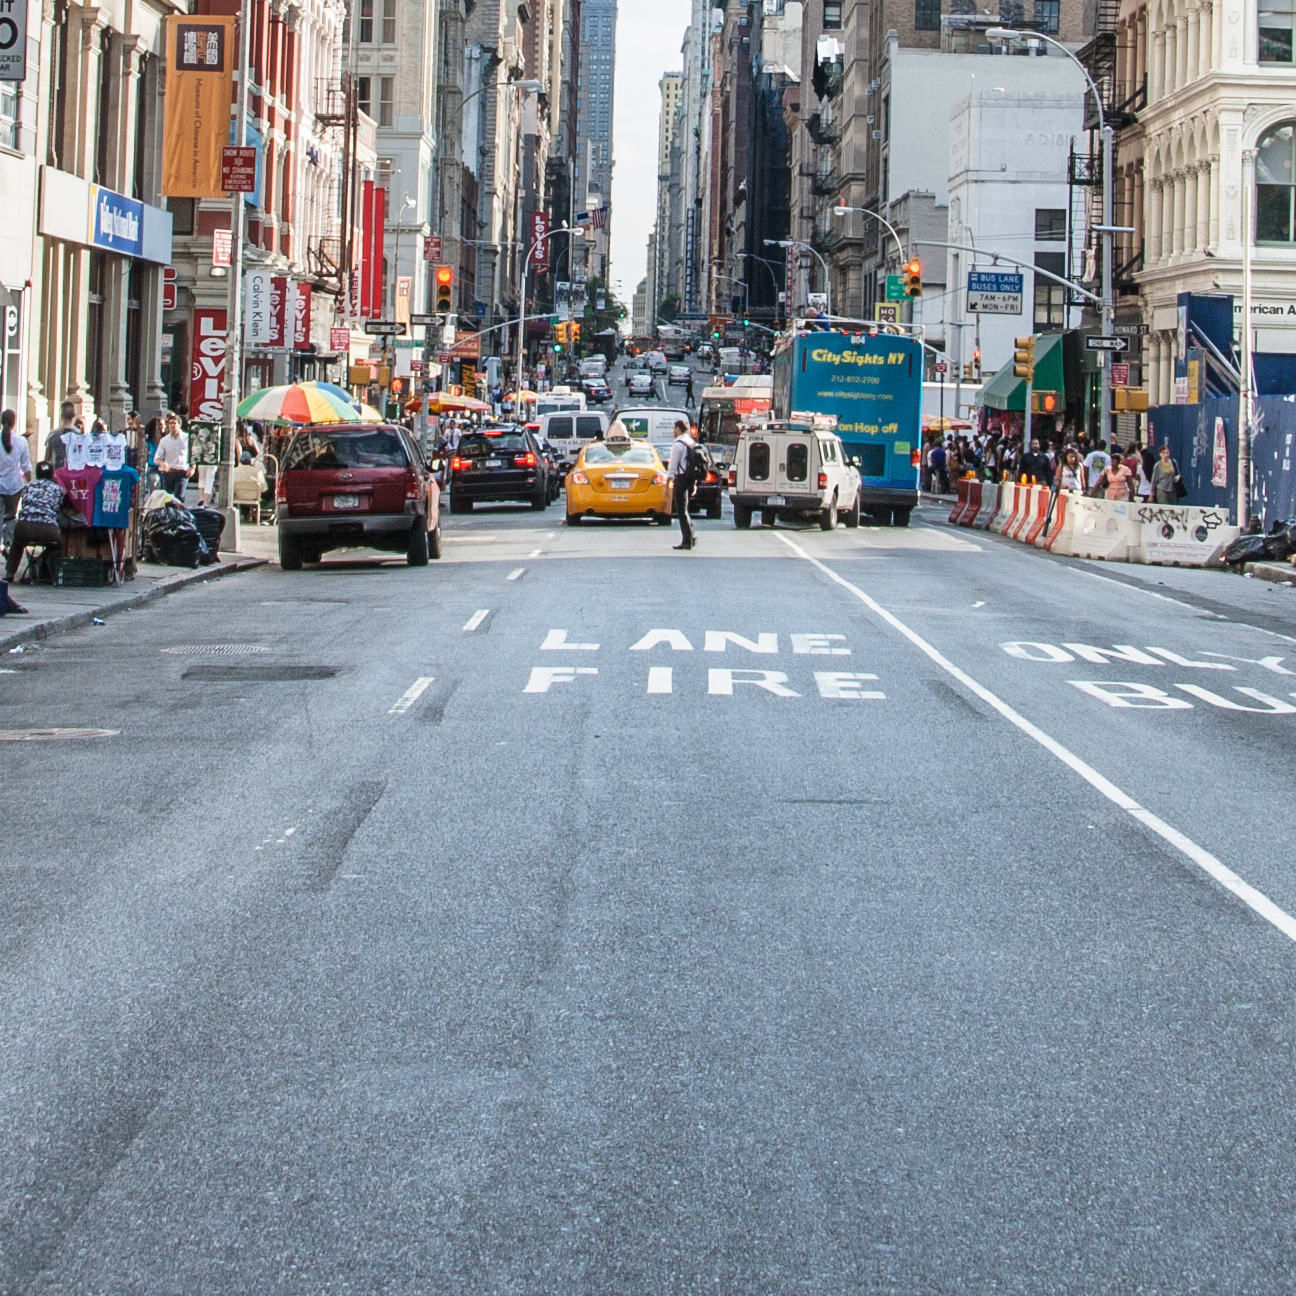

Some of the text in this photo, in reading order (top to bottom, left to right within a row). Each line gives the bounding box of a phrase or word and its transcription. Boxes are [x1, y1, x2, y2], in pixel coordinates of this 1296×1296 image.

[980, 274, 1020, 283] BUS LANE
[971, 283, 1021, 292] BUSES ONLY
[251, 275, 264, 337] Calvin Klein
[1139, 325, 1148, 335] ST
[811, 348, 905, 366] CitySights NY
[854, 422, 879, 435] Hop
[881, 422, 898, 434] off
[538, 627, 855, 657] LANE
[522, 666, 888, 700] FIRE
